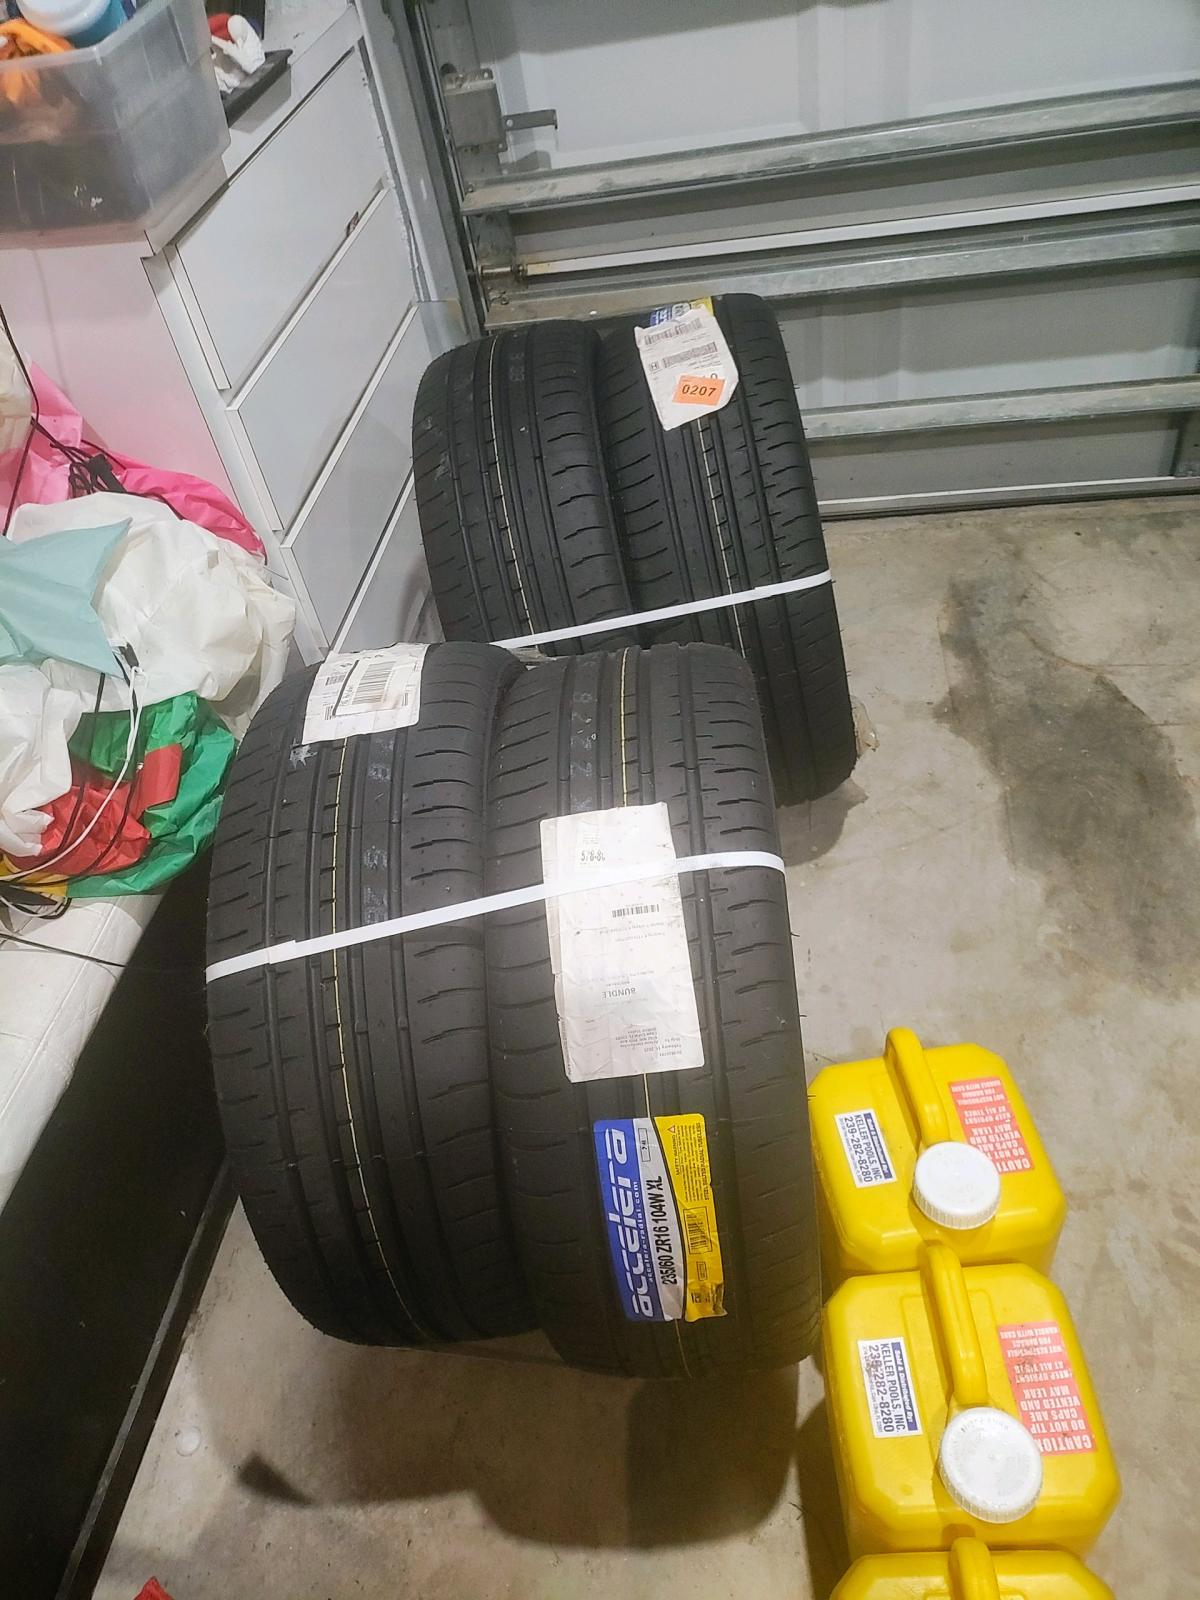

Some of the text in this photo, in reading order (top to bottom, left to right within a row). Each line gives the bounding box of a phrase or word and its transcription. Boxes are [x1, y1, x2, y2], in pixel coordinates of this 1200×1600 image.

[682, 385, 717, 397] 0207
[601, 987, 636, 998] BUNDLE
[854, 1114, 869, 1140] KELLER
[971, 1123, 1011, 1136] MAY LEAK
[970, 1131, 1021, 1145] VENTED AND
[995, 1140, 1018, 1150] CAPS
[844, 1116, 873, 1183] 239-282-8280
[996, 1158, 1031, 1173] CAUTI
[606, 1129, 653, 1316] accelera
[646, 1176, 677, 1284] 235/60 ZR16 104W XL
[1040, 1362, 1052, 1371] ALL
[880, 1343, 895, 1377] KELLER
[894, 1414, 906, 1432] INC.
[1023, 1385, 1070, 1399] MAY LEAK
[1020, 1396, 1080, 1410] VENTED AND
[1029, 1408, 1078, 1421] CAPS ARE
[1030, 1420, 1086, 1434] DO NOT TIP
